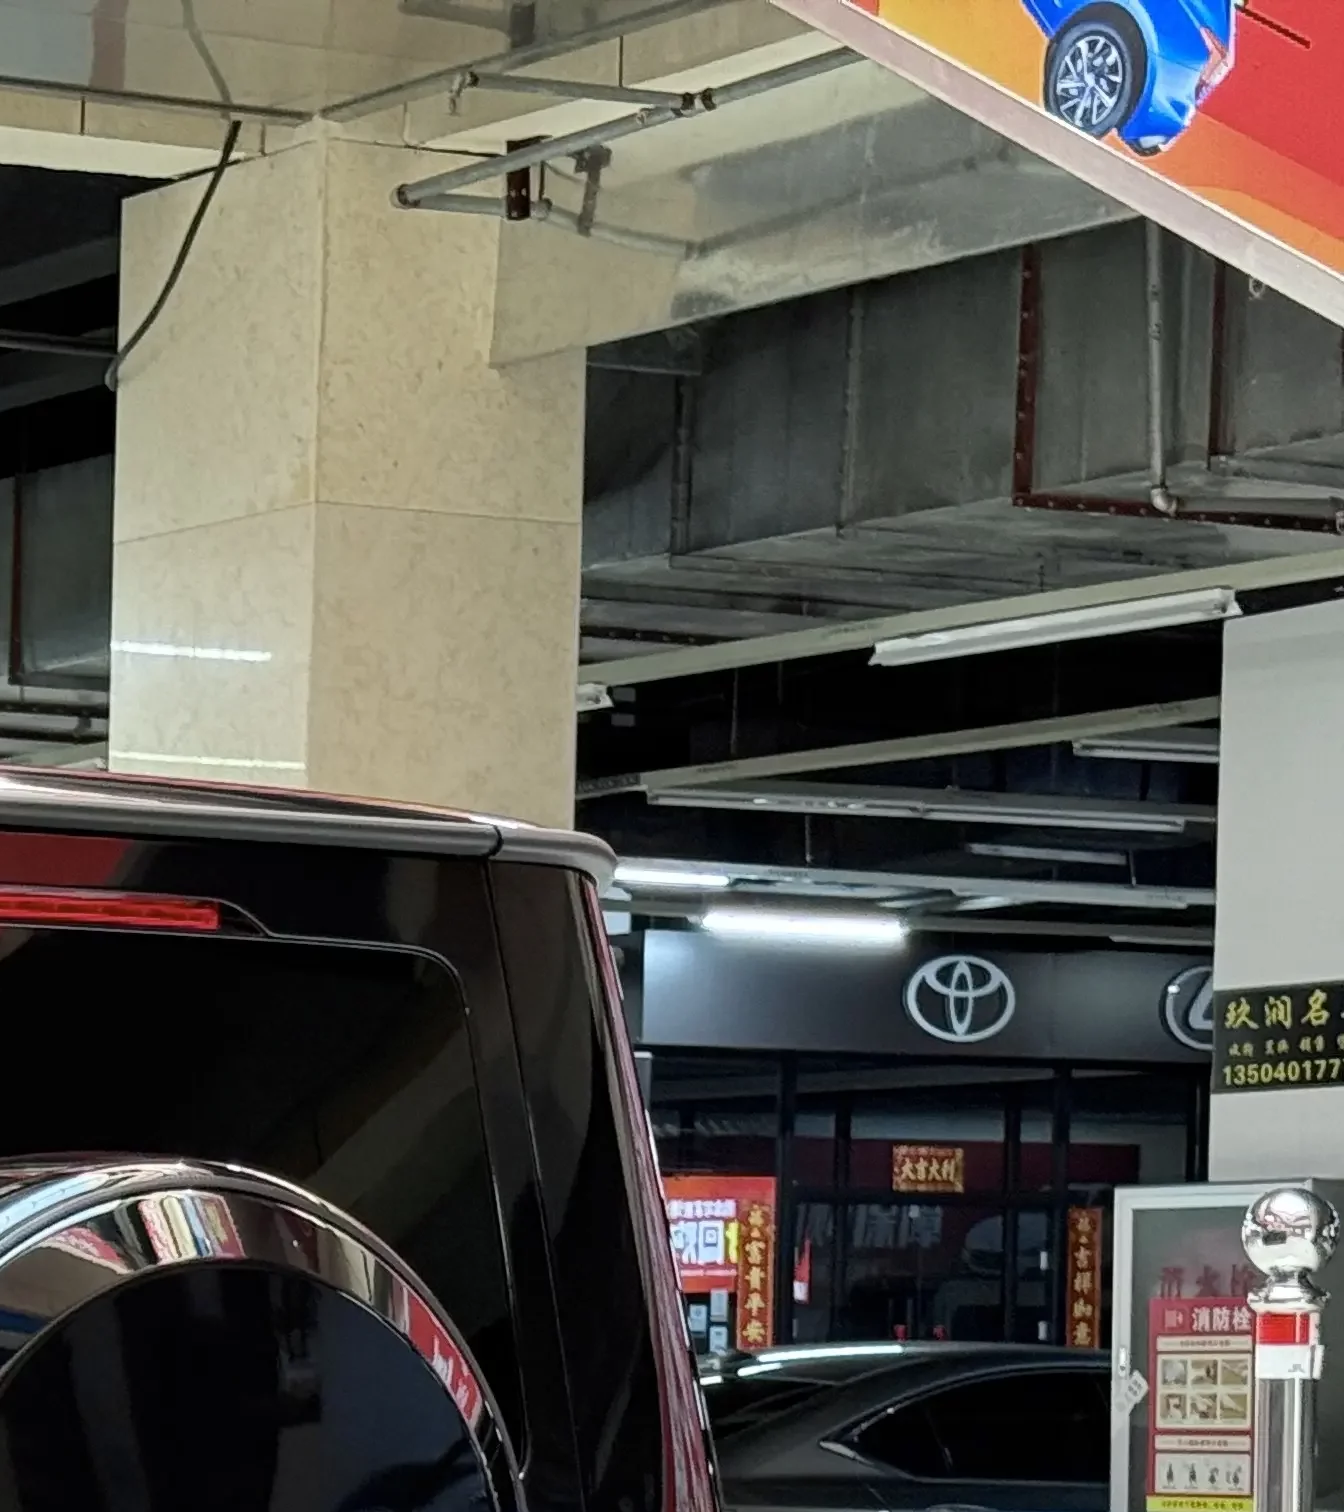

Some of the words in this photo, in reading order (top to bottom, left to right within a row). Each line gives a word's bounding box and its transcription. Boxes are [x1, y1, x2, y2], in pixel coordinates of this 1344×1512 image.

[1224, 988, 1344, 1029] 玖润名
[1223, 1058, 1344, 1085] 135040177
[1192, 1306, 1252, 1332] 消防栓
